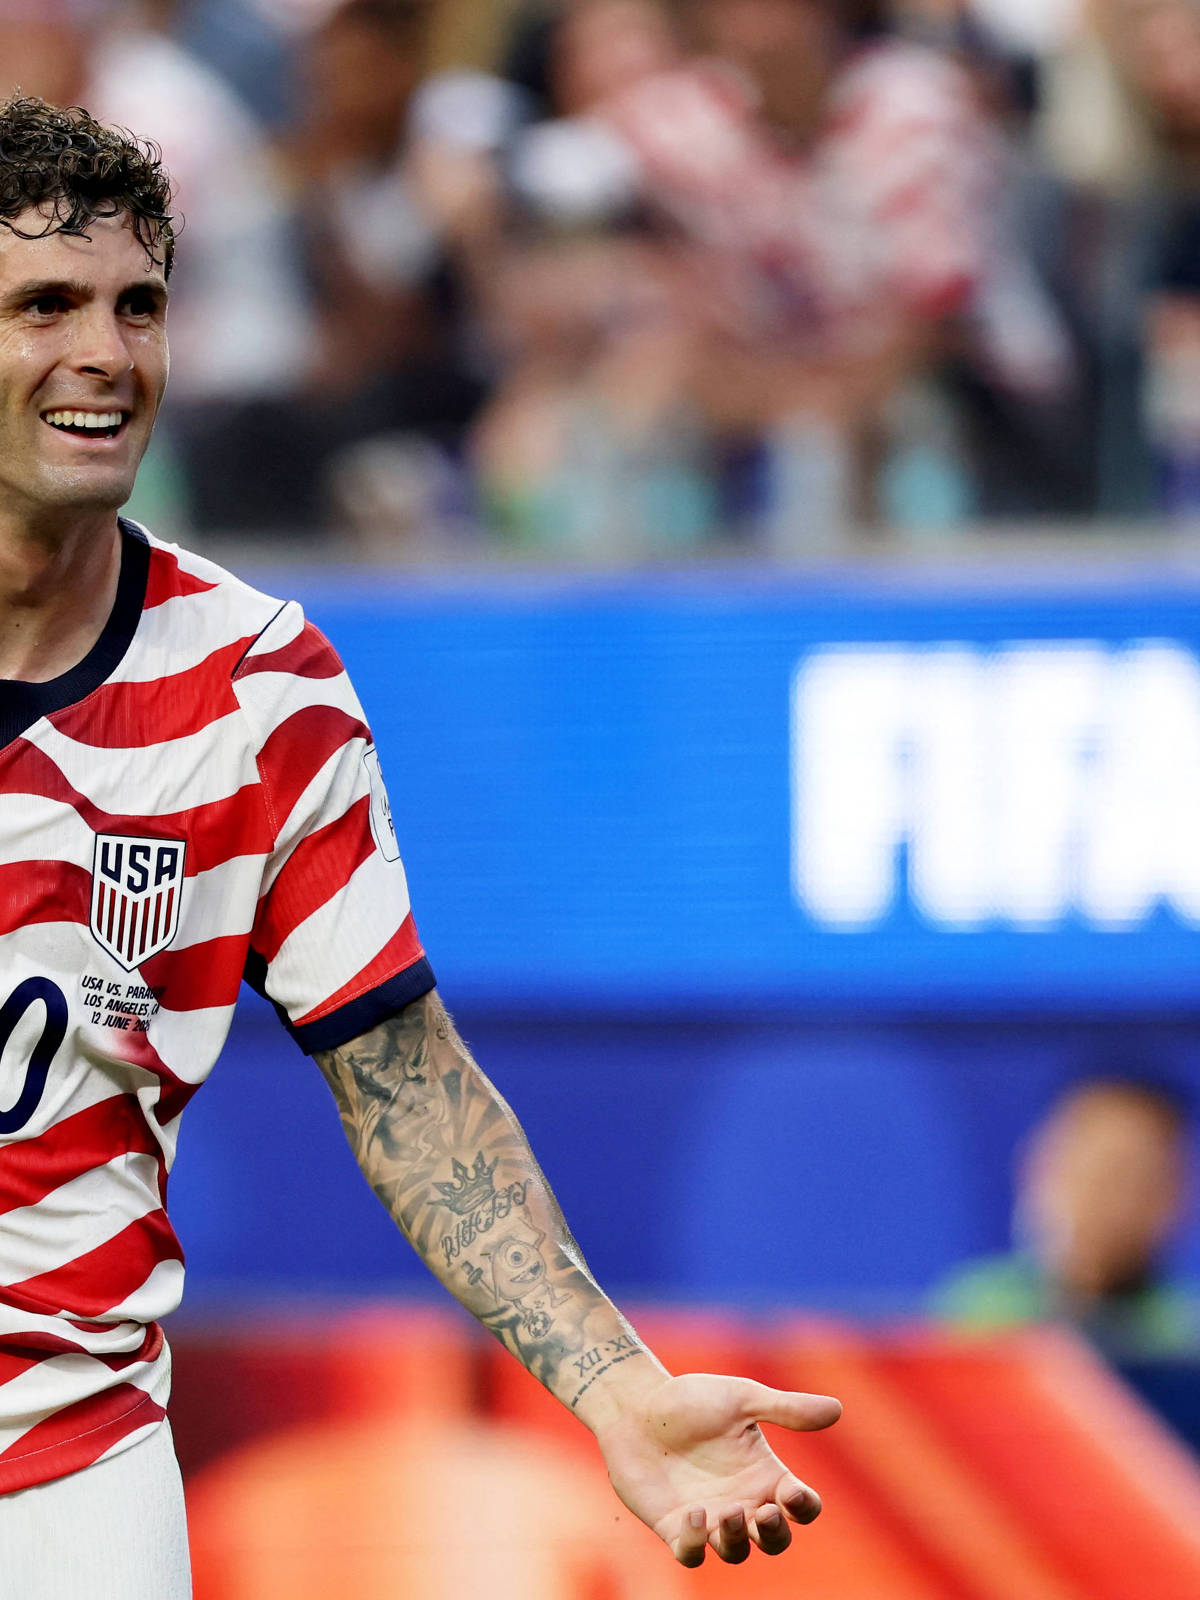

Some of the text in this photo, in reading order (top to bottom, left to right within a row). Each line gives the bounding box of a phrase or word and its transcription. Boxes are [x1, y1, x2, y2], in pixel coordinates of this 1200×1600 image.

[100, 841, 179, 894] USA
[81, 975, 104, 991] USA
[106, 982, 122, 996] VS.
[83, 993, 104, 1008] LOS
[104, 998, 149, 1017] ANGELES,
[91, 1011, 101, 1025] 12
[102, 1014, 132, 1030] JUNE
